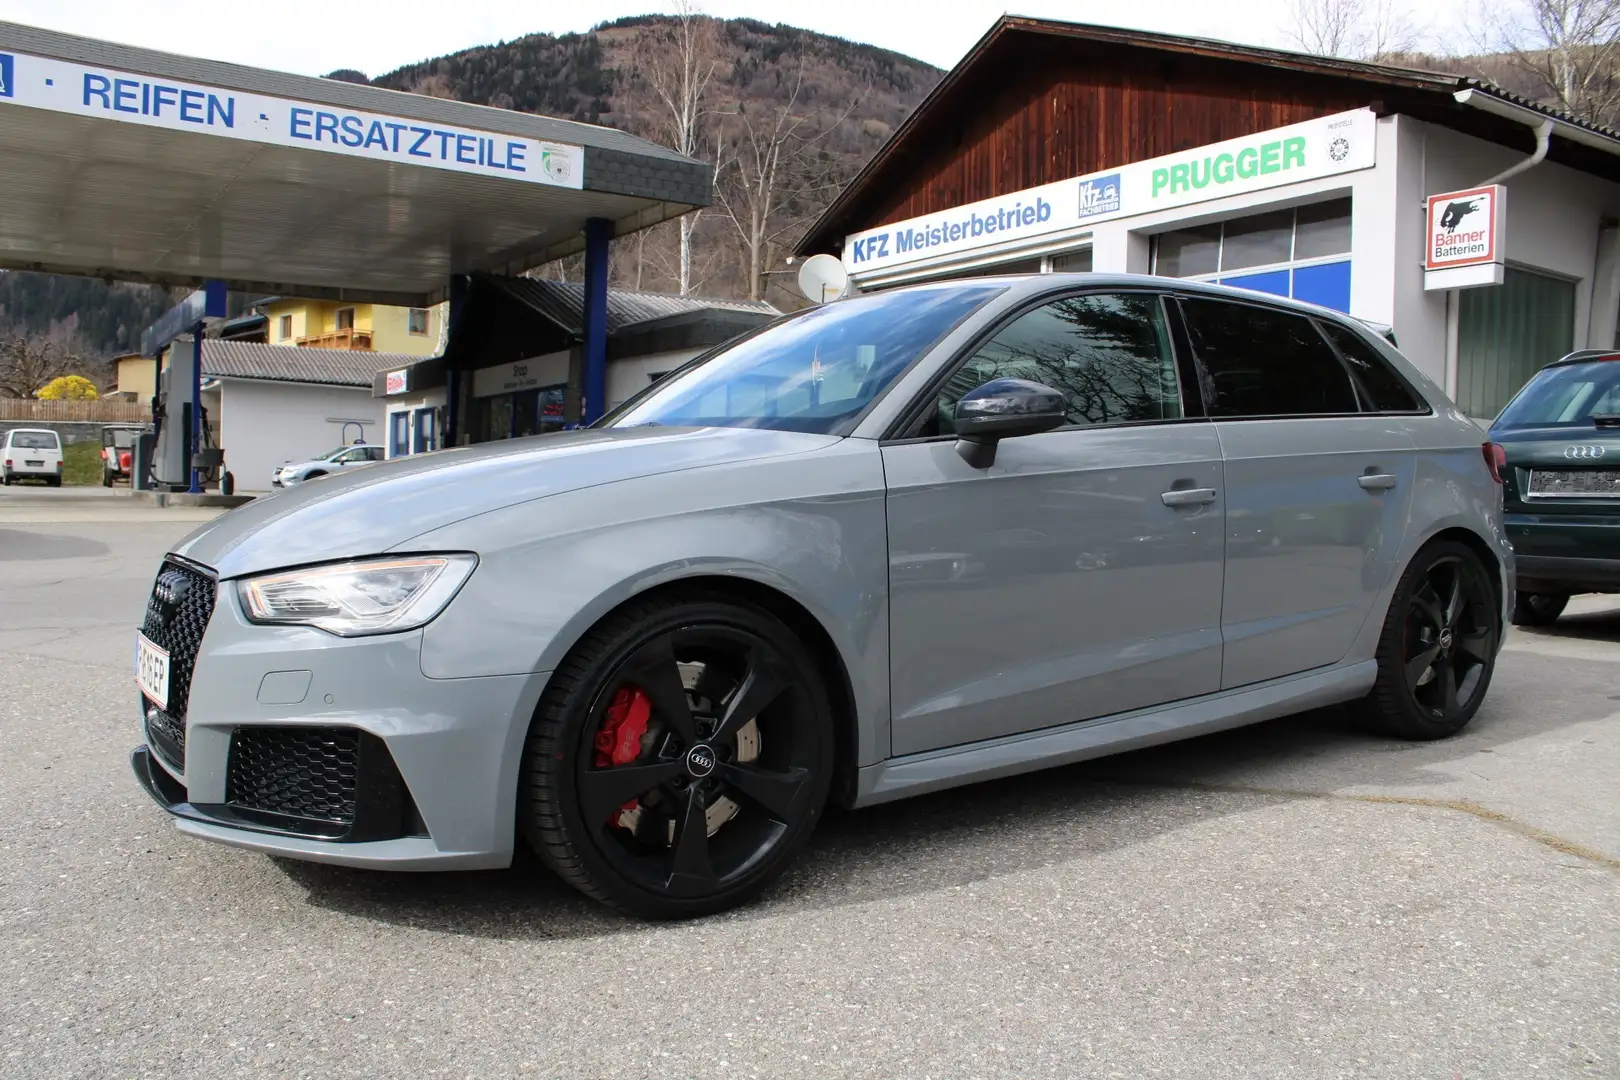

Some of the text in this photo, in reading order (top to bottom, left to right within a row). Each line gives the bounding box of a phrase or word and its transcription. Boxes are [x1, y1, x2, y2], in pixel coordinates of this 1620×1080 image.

[83, 73, 527, 172] REIFEN ERSATZTEILE
[1152, 136, 1306, 198] PRUGGER
[1080, 181, 1102, 209] Kfz
[1080, 201, 1119, 217] FACHBETRIEB
[853, 197, 1051, 263] KFZ Meisterbetrieb
[1435, 230, 1486, 247] Banner
[1435, 243, 1485, 257] Batterien
